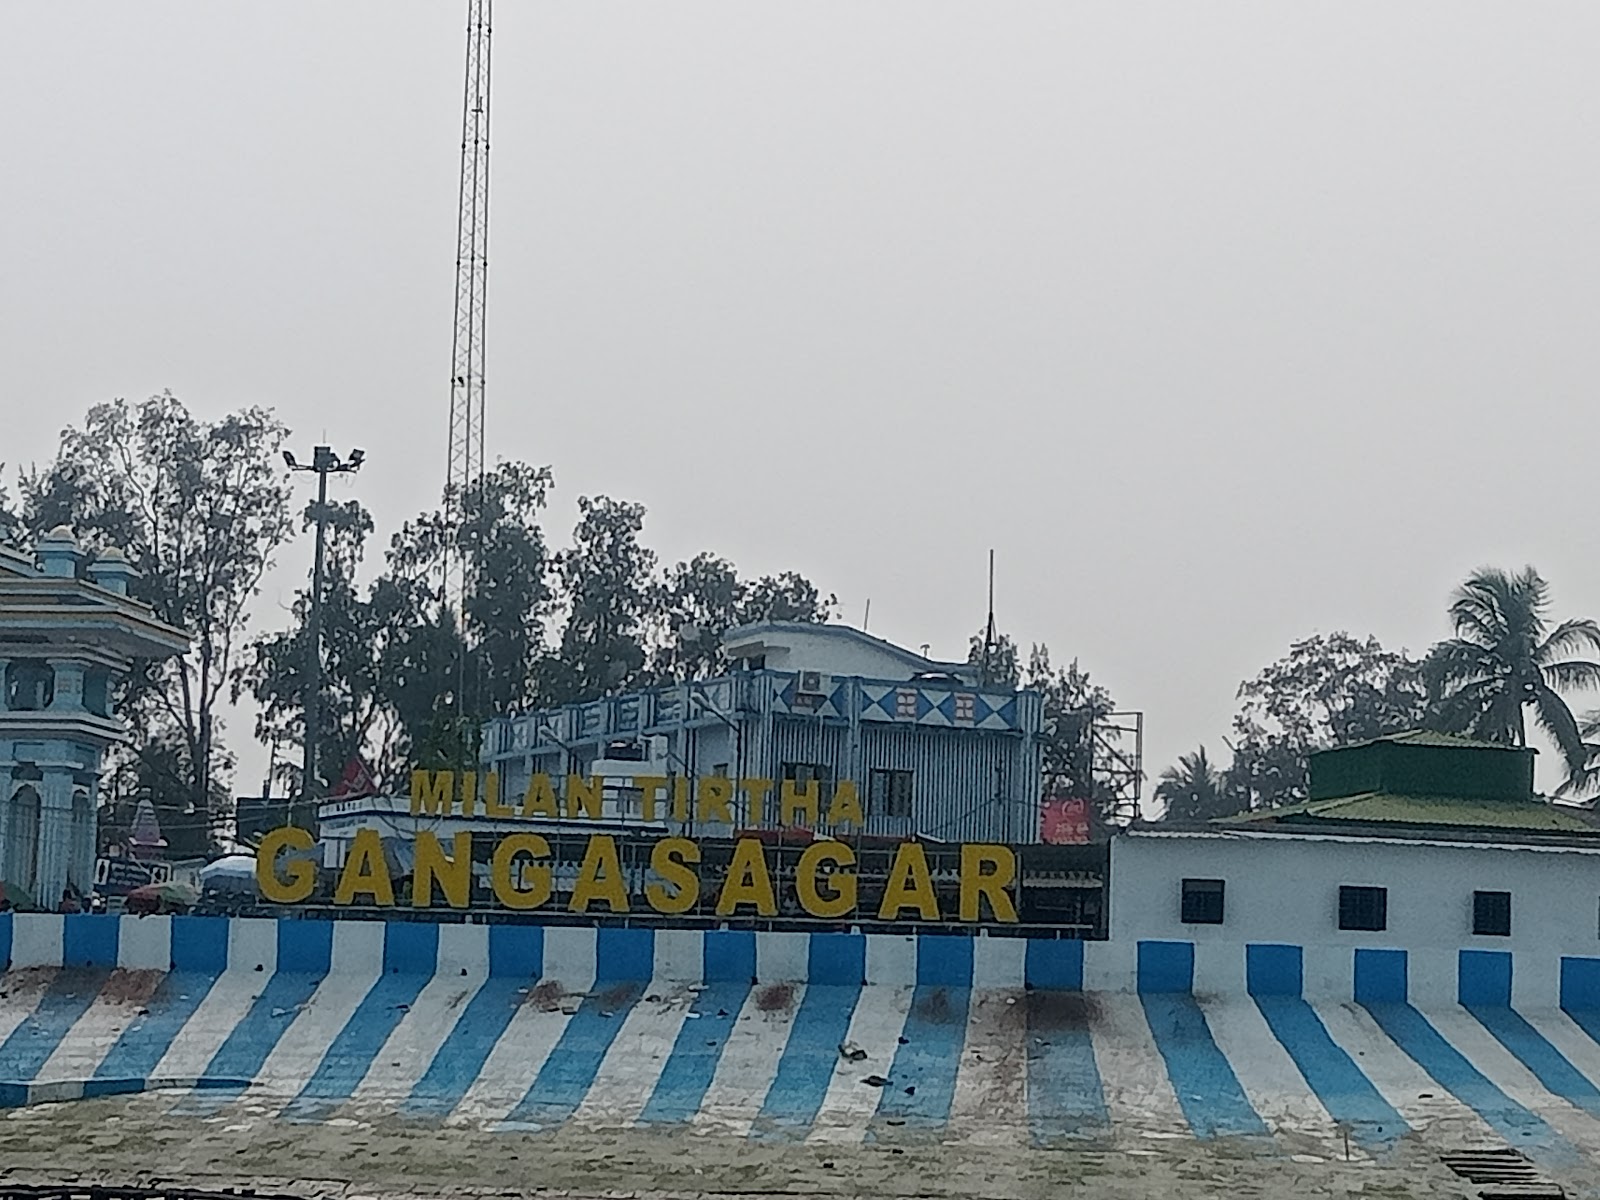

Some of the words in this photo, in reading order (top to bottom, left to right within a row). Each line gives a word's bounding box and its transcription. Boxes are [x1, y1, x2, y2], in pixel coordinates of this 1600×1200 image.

[411, 769, 603, 818] MILAN
[636, 776, 865, 825] TIRTHA
[256, 825, 1020, 923] GANGASAGAR
